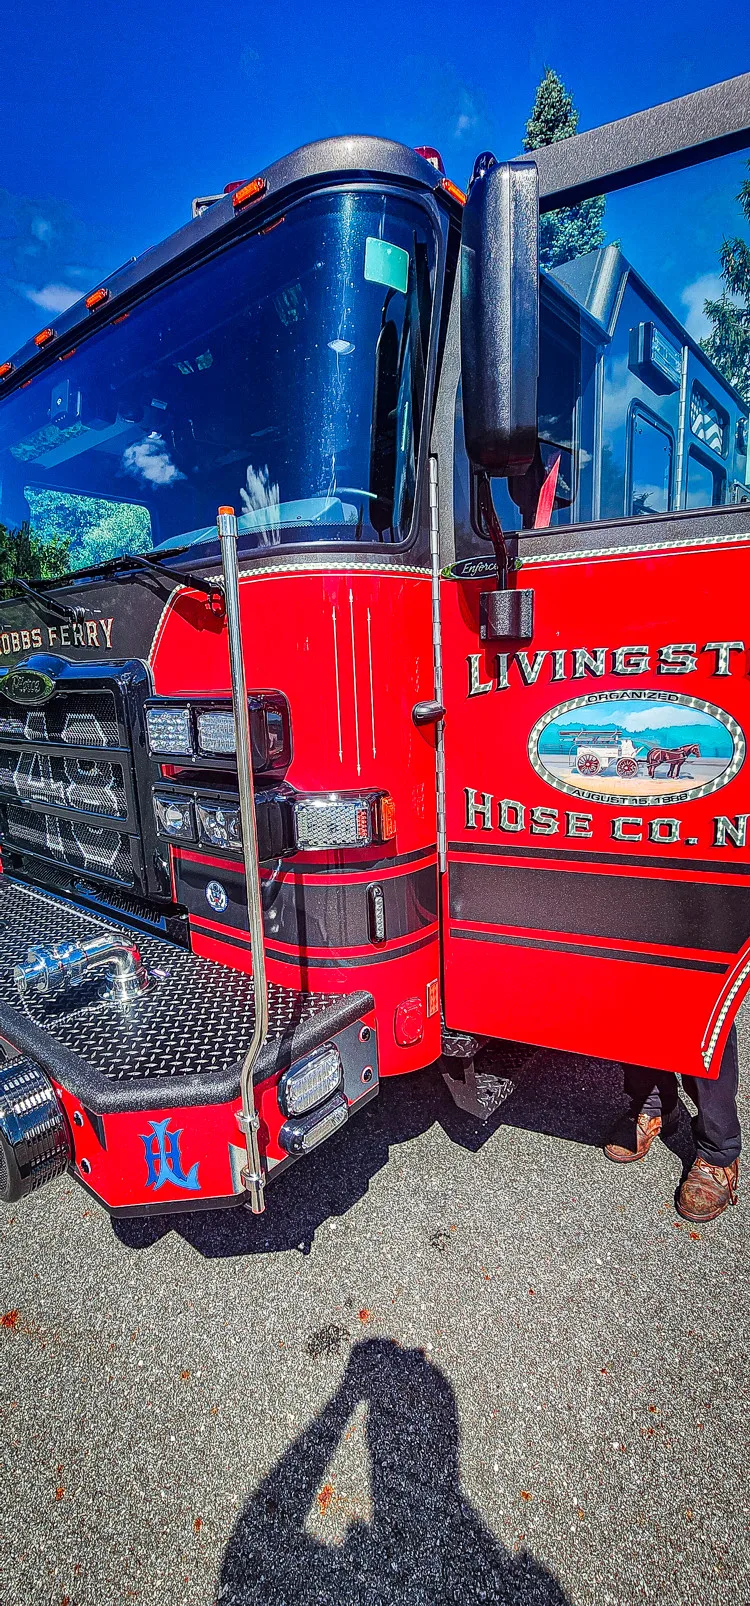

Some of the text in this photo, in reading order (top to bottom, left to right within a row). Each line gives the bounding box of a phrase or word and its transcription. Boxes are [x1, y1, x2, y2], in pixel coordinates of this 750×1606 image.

[0, 617, 115, 655] OBBS FERRY
[465, 640, 750, 698] LIVINGST
[587, 690, 679, 703] ORGANIZED
[571, 788, 688, 806] AUGUST 15, 1888
[463, 786, 594, 839] HOSE
[610, 816, 698, 847] CO.
